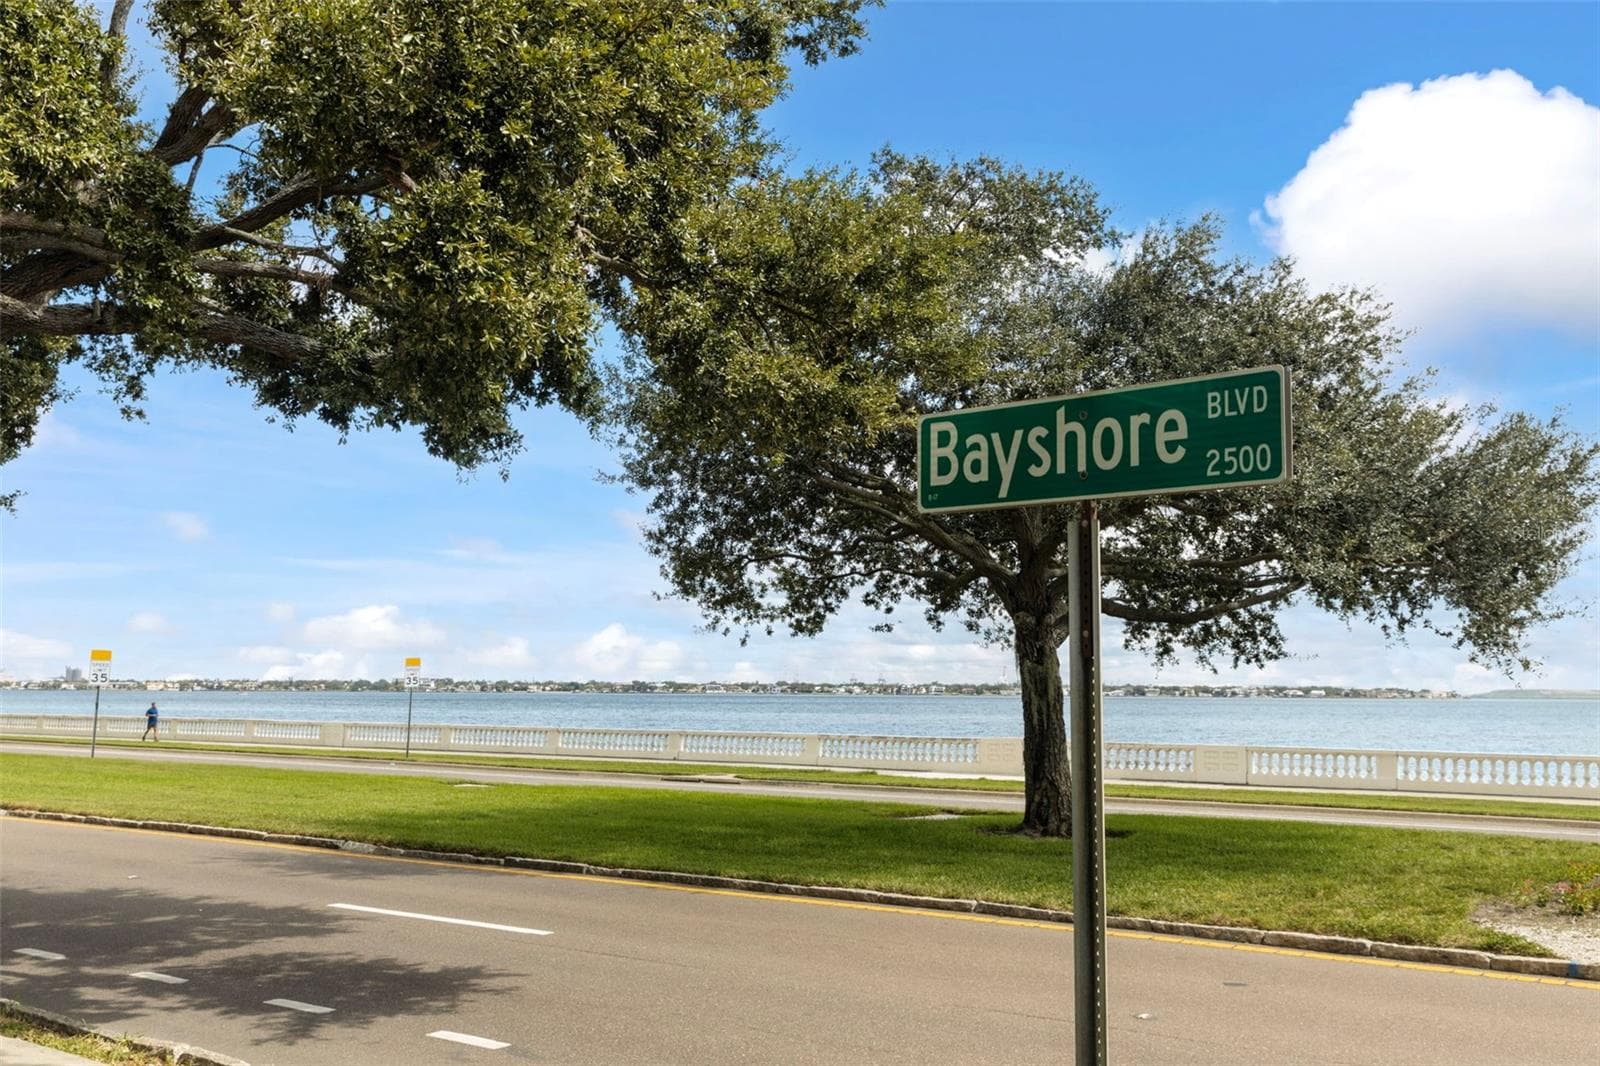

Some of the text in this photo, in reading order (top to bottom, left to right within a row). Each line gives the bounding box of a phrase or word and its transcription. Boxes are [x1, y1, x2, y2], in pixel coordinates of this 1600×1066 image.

[1207, 385, 1268, 419] BLVD
[930, 405, 1188, 499] Bayshore
[1206, 443, 1272, 477] 2500
[91, 673, 108, 683] 35
[406, 677, 419, 685] 35
